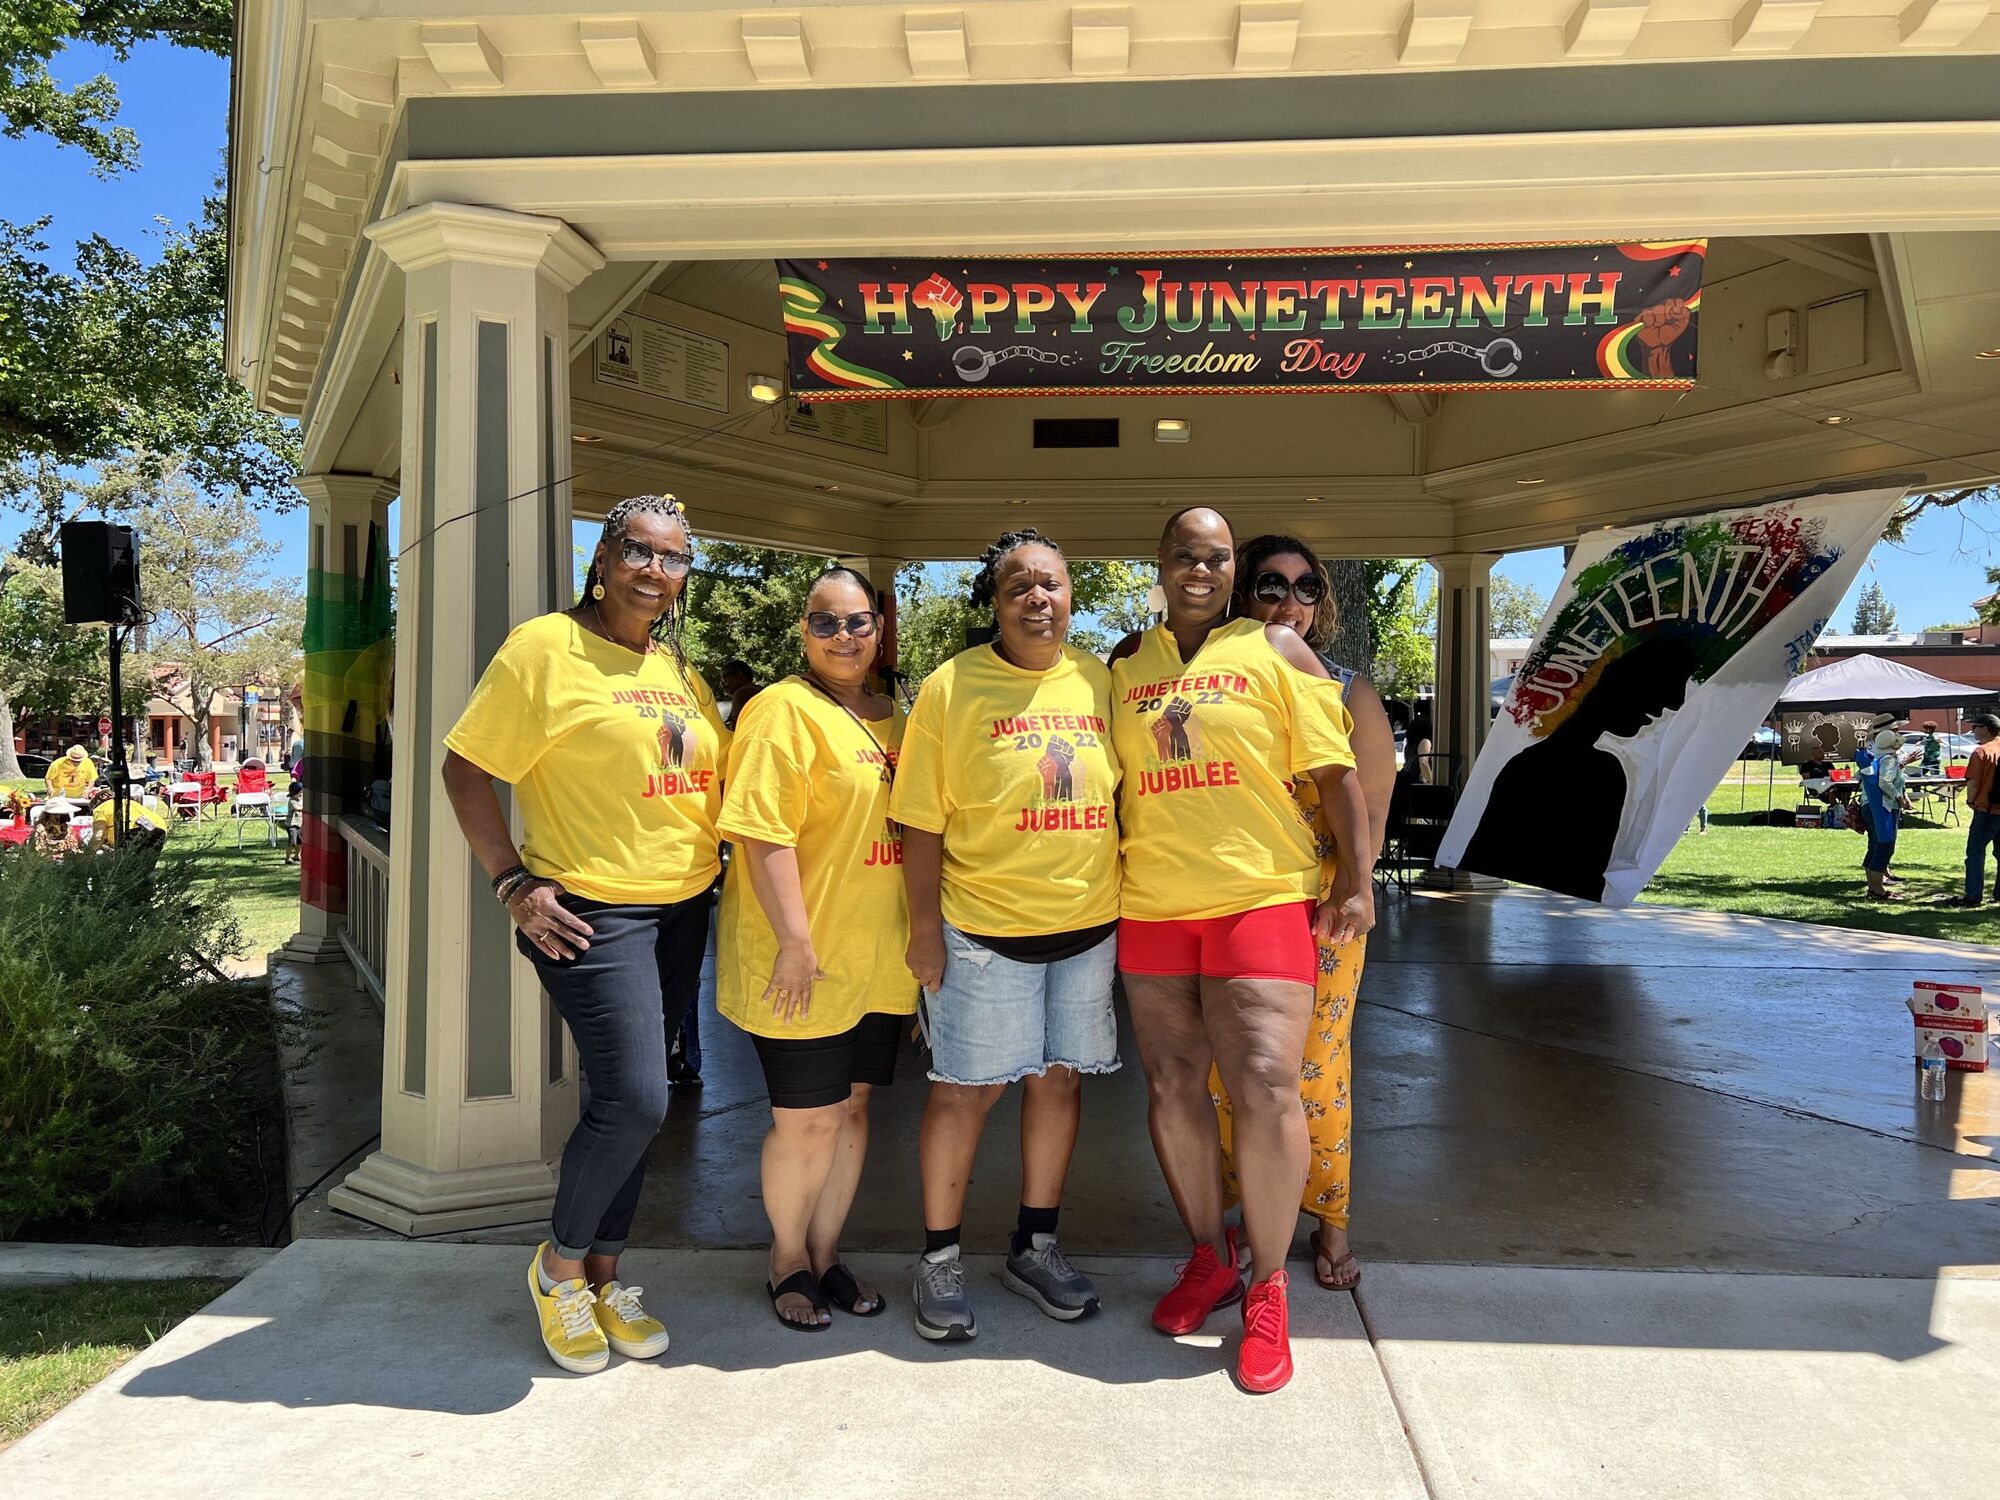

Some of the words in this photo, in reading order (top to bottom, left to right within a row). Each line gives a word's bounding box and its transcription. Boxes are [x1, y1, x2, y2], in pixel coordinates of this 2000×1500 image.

[1116, 270, 1622, 333] JUNETEENTH
[1099, 340, 1261, 374] Freedom
[1280, 338, 1367, 379] Day
[1526, 545, 1799, 716] JUNETEENTH
[612, 690, 696, 707] JUNETEEN
[1122, 675, 1248, 704] JUNETEENTH
[1196, 691, 1224, 704] 22
[634, 705, 657, 718] 20
[679, 708, 701, 719] 22
[1136, 698, 1162, 714] 20
[991, 715, 1105, 738] JUNETEENTH
[1013, 733, 1042, 751] 20
[1073, 732, 1097, 748] 22
[641, 770, 713, 798] JUBILEE
[1138, 761, 1240, 796] JUBILEE
[1015, 805, 1108, 832] JUBILEE
